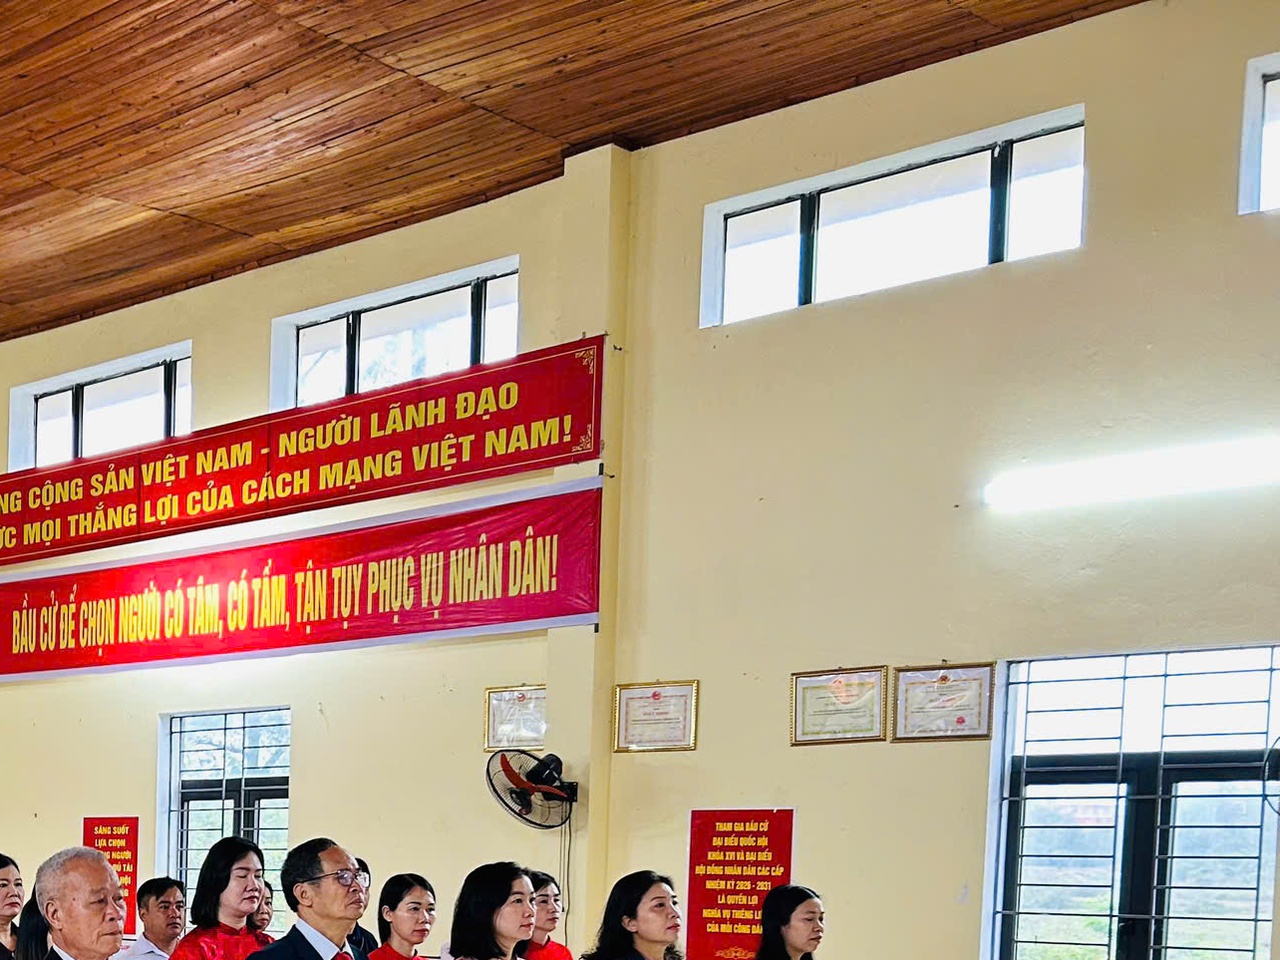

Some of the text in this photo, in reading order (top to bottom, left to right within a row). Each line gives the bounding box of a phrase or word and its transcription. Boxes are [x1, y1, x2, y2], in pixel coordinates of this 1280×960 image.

[23, 517, 61, 546] MỌI
[67, 502, 137, 538] THẮNG
[144, 493, 178, 525] LỢI
[186, 481, 234, 516] CỦA
[242, 468, 310, 505] CÁCH
[319, 450, 402, 490] MẠNG
[412, 433, 475, 472] VIỆT
[484, 414, 572, 458] NAM!
[28, 478, 83, 509] CỘNG
[90, 464, 134, 497] SẢN
[141, 453, 189, 488] VIỆT
[196, 440, 252, 476] NAM
[278, 413, 360, 458] NGƯỜI
[370, 396, 446, 439] LÃNH
[456, 381, 518, 420] ĐẠO
[12, 592, 37, 654] BẦU
[40, 590, 59, 652] CỬ
[60, 583, 78, 650] ĐỂ
[80, 598, 115, 656] CHỌN
[118, 581, 162, 644] NGƯỜI
[164, 578, 184, 638] CÓ
[186, 575, 223, 639] TÂM,
[227, 568, 249, 632] CÓ
[295, 560, 327, 634] TẬN
[332, 563, 363, 629] TỤY
[367, 556, 415, 623] PHỤC
[421, 551, 444, 619] VỤ
[449, 533, 504, 604] NHÂN
[508, 526, 559, 597] DÂN!
